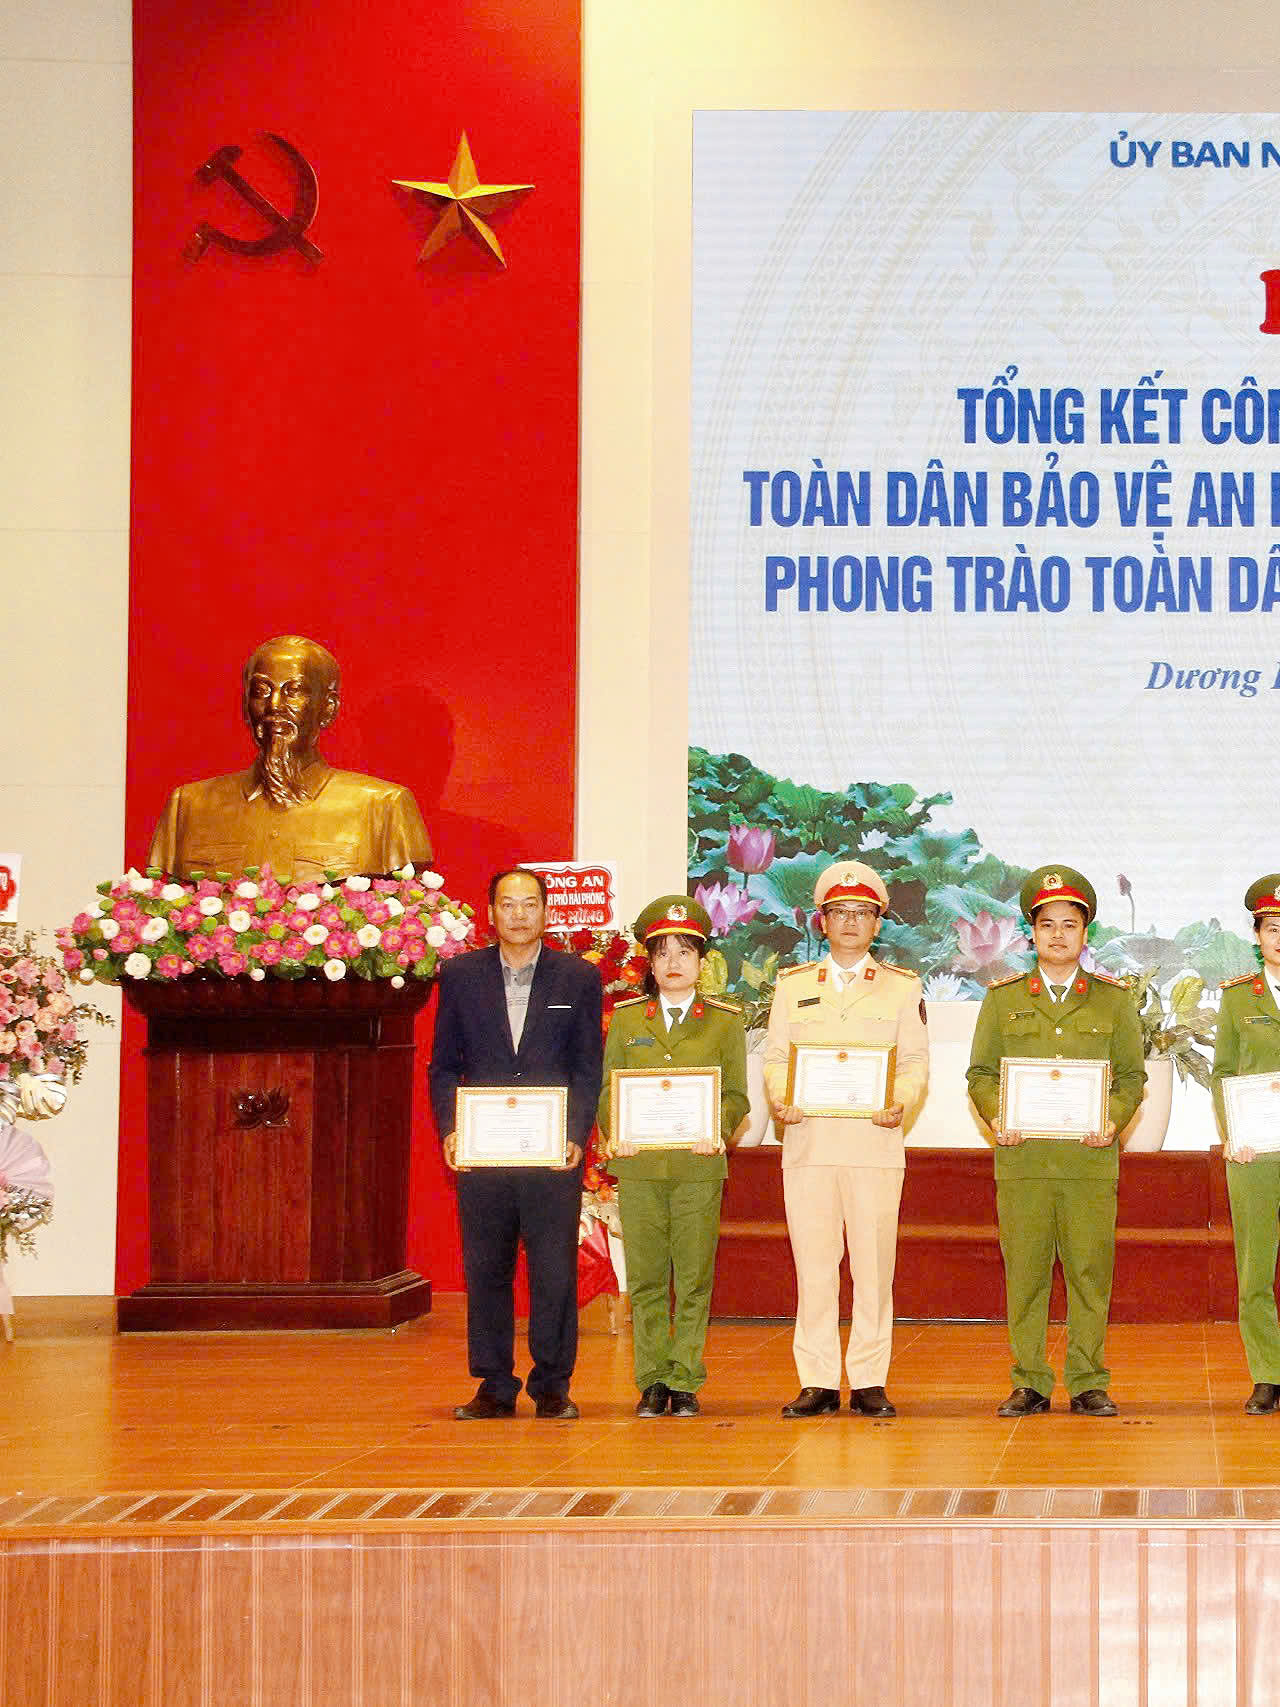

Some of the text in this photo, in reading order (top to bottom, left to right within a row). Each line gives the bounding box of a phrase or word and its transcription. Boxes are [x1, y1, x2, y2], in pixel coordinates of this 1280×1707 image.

[1109, 129, 1161, 169] ỦY
[1171, 141, 1251, 169] BAN
[956, 364, 1085, 445] TỔNG
[1100, 369, 1189, 445] KẾT
[743, 457, 871, 528] TOÀN
[886, 458, 988, 528] DÂN
[1002, 451, 1100, 529] BẢO
[1114, 459, 1173, 541] VỆ
[1186, 471, 1255, 528] AN
[765, 555, 933, 613] PHONG
[946, 543, 1071, 613] TRÀO
[1084, 543, 1213, 614] TOÀN
[1145, 661, 1262, 698] Dương
[545, 874, 604, 889] ÔNG AN
